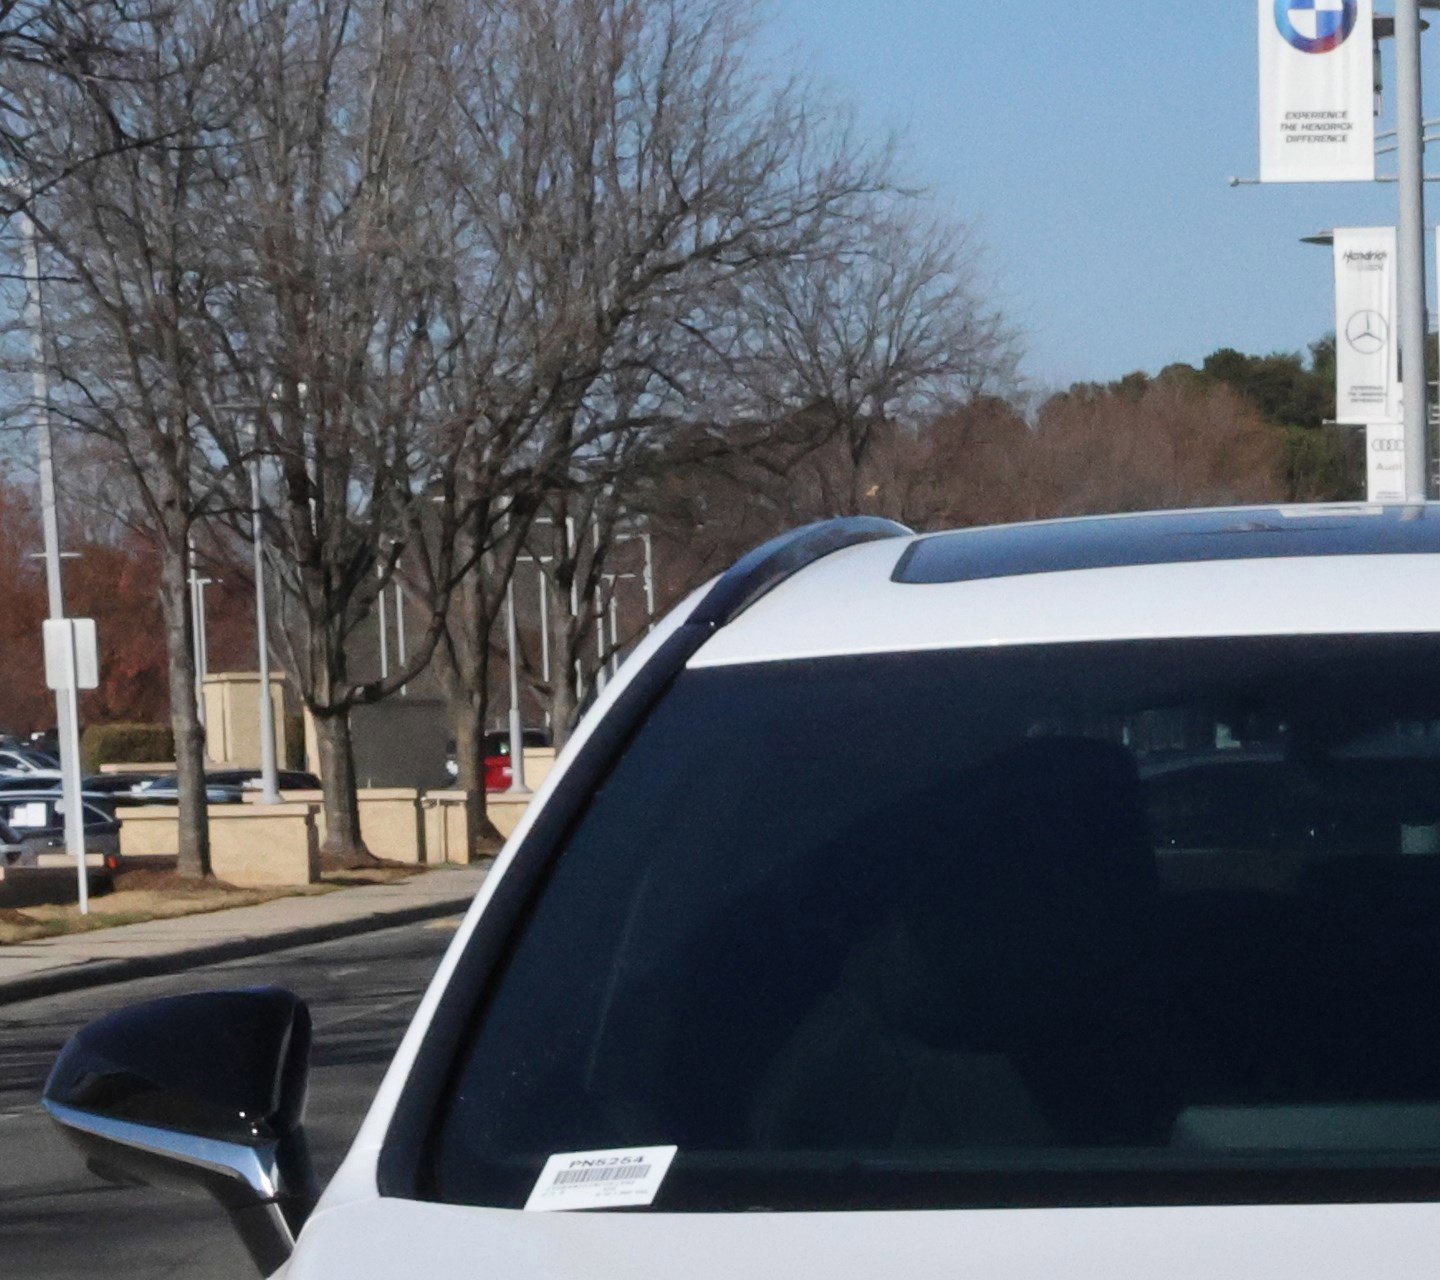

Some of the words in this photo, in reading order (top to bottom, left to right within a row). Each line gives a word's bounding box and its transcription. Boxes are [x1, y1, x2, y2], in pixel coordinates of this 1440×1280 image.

[1285, 111, 1347, 120] EXPERIENCE
[1280, 122, 1297, 131] THE
[1301, 122, 1353, 131] HENDRICK
[1285, 134, 1347, 143] DIFFERENCE
